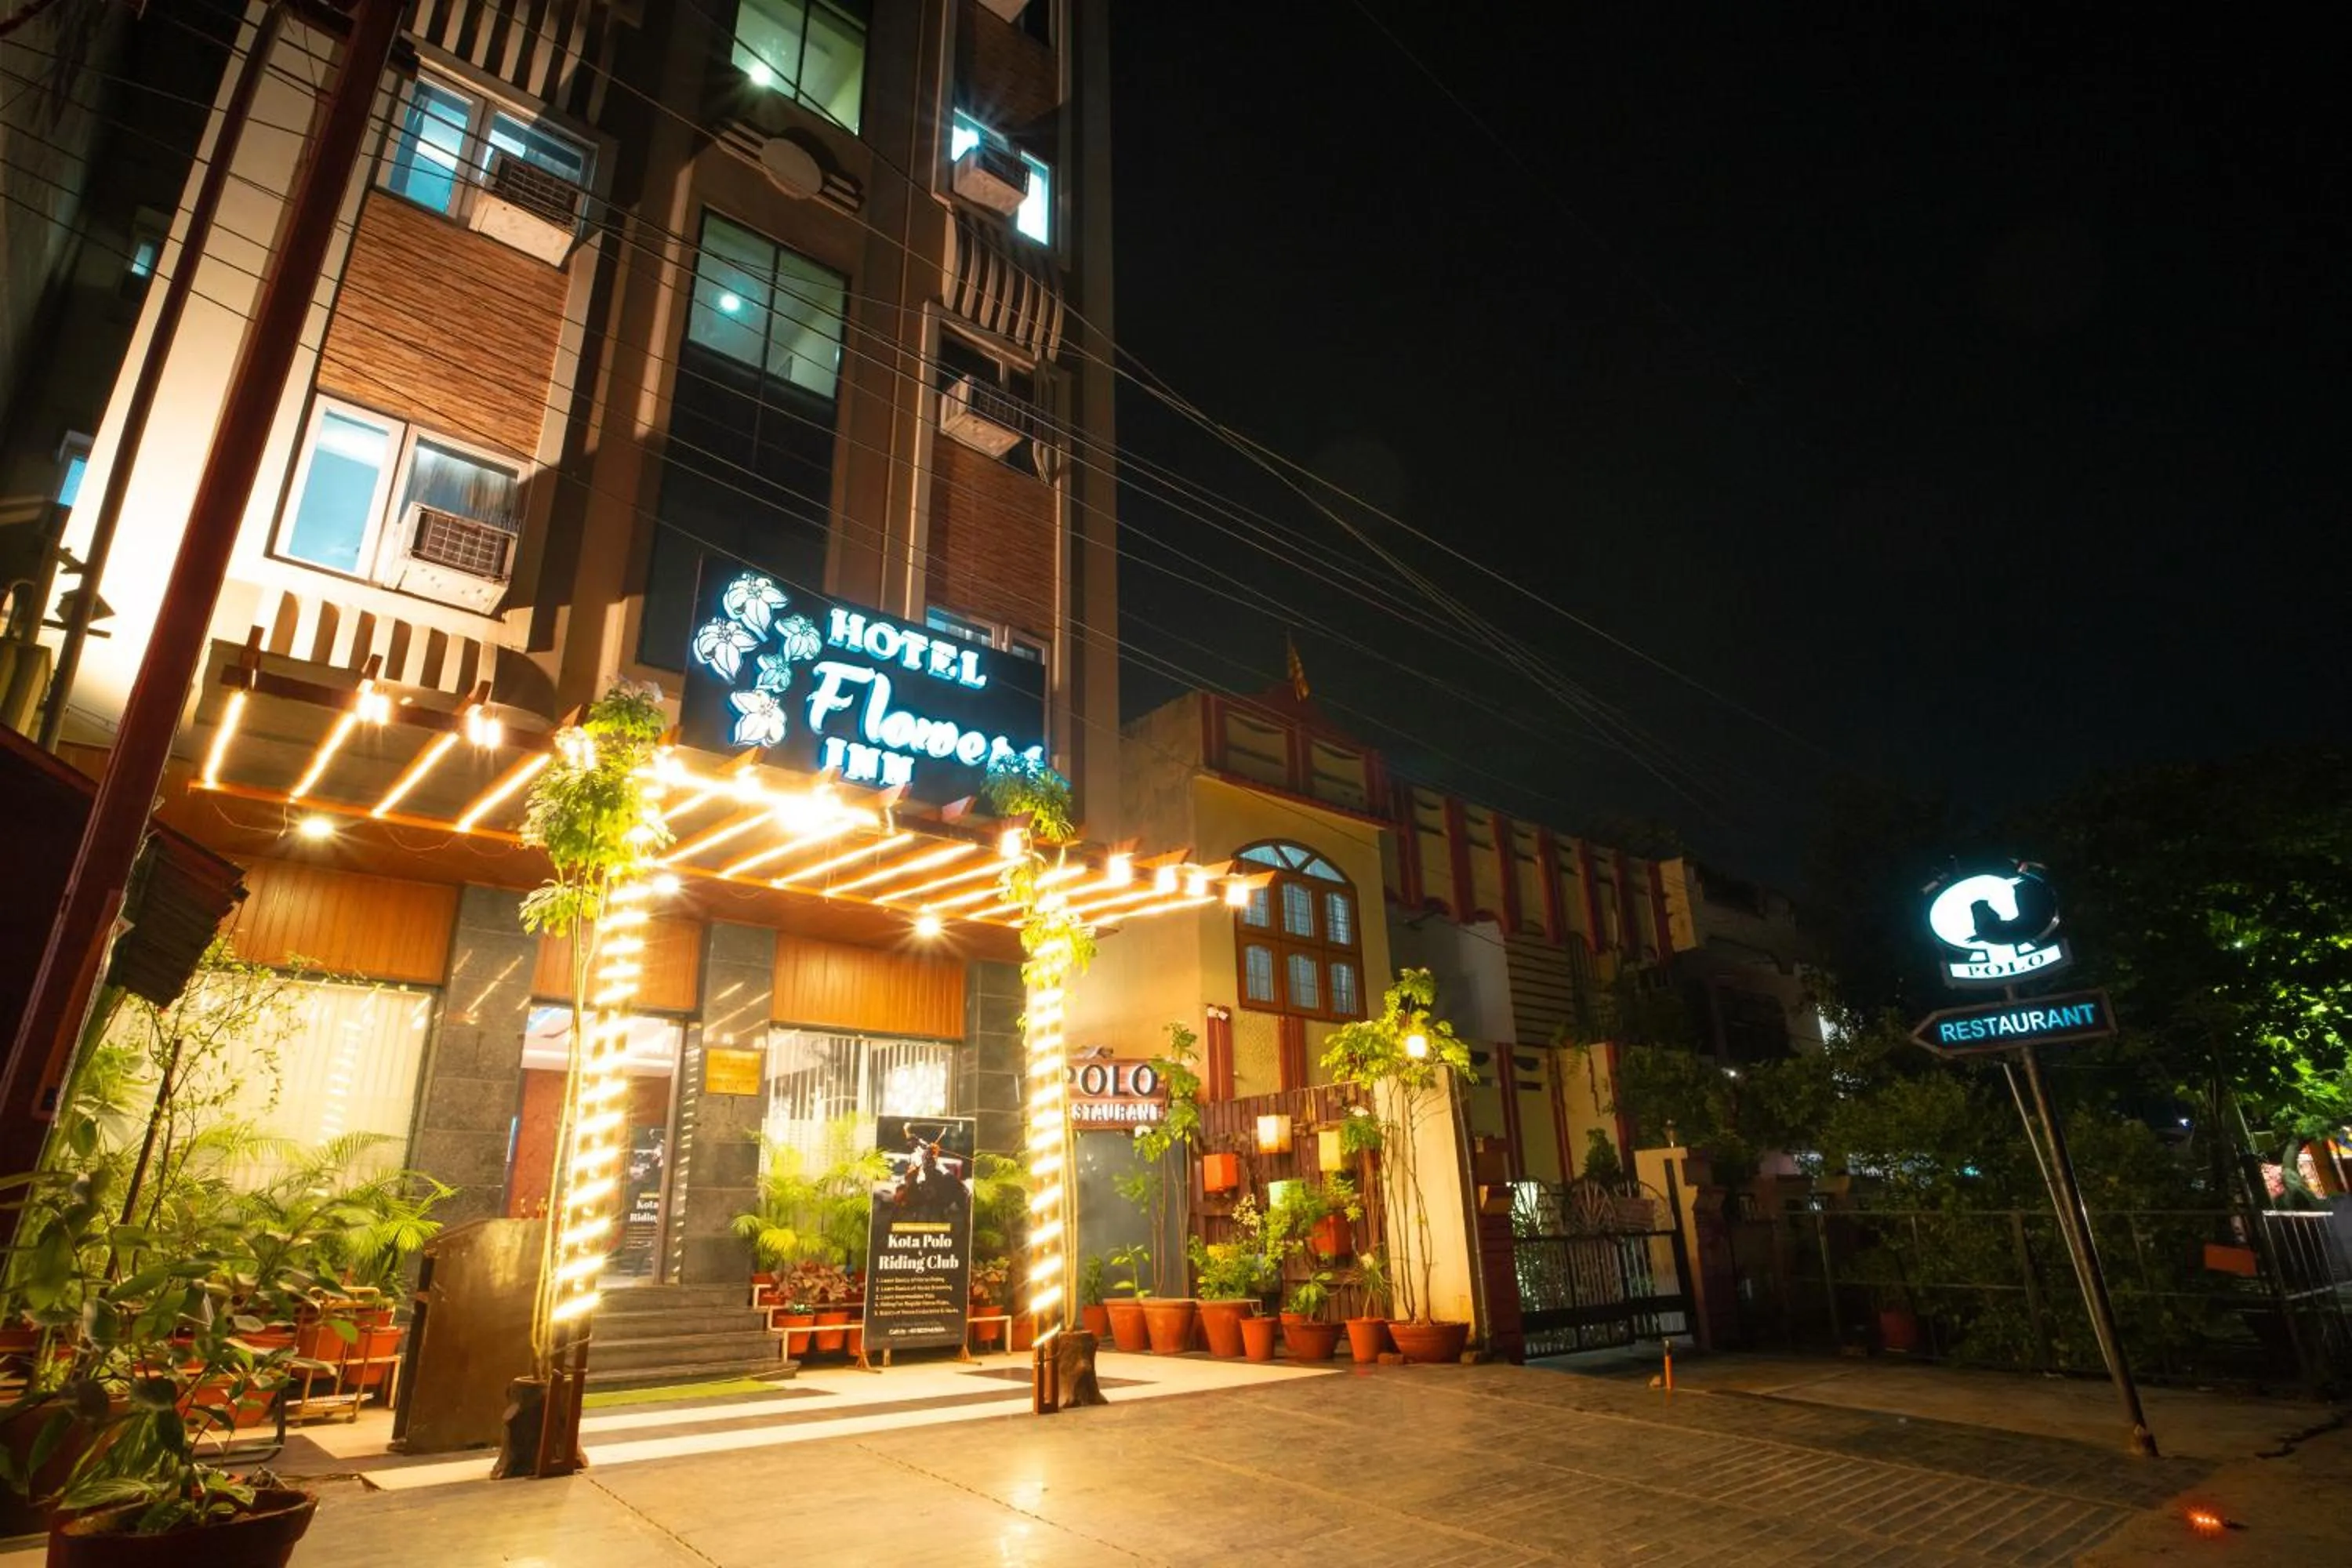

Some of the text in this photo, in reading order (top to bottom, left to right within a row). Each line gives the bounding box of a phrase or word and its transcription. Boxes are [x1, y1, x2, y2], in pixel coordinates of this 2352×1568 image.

[827, 607, 987, 689] HOTEL
[821, 737, 915, 786] INN
[1967, 954, 2045, 976] POLO
[1940, 1004, 2095, 1042] RESTAURANT
[1065, 1104, 1164, 1121] STAURANT
[887, 1233, 953, 1248] Kota Polo
[878, 1254, 960, 1274] Riding Club
